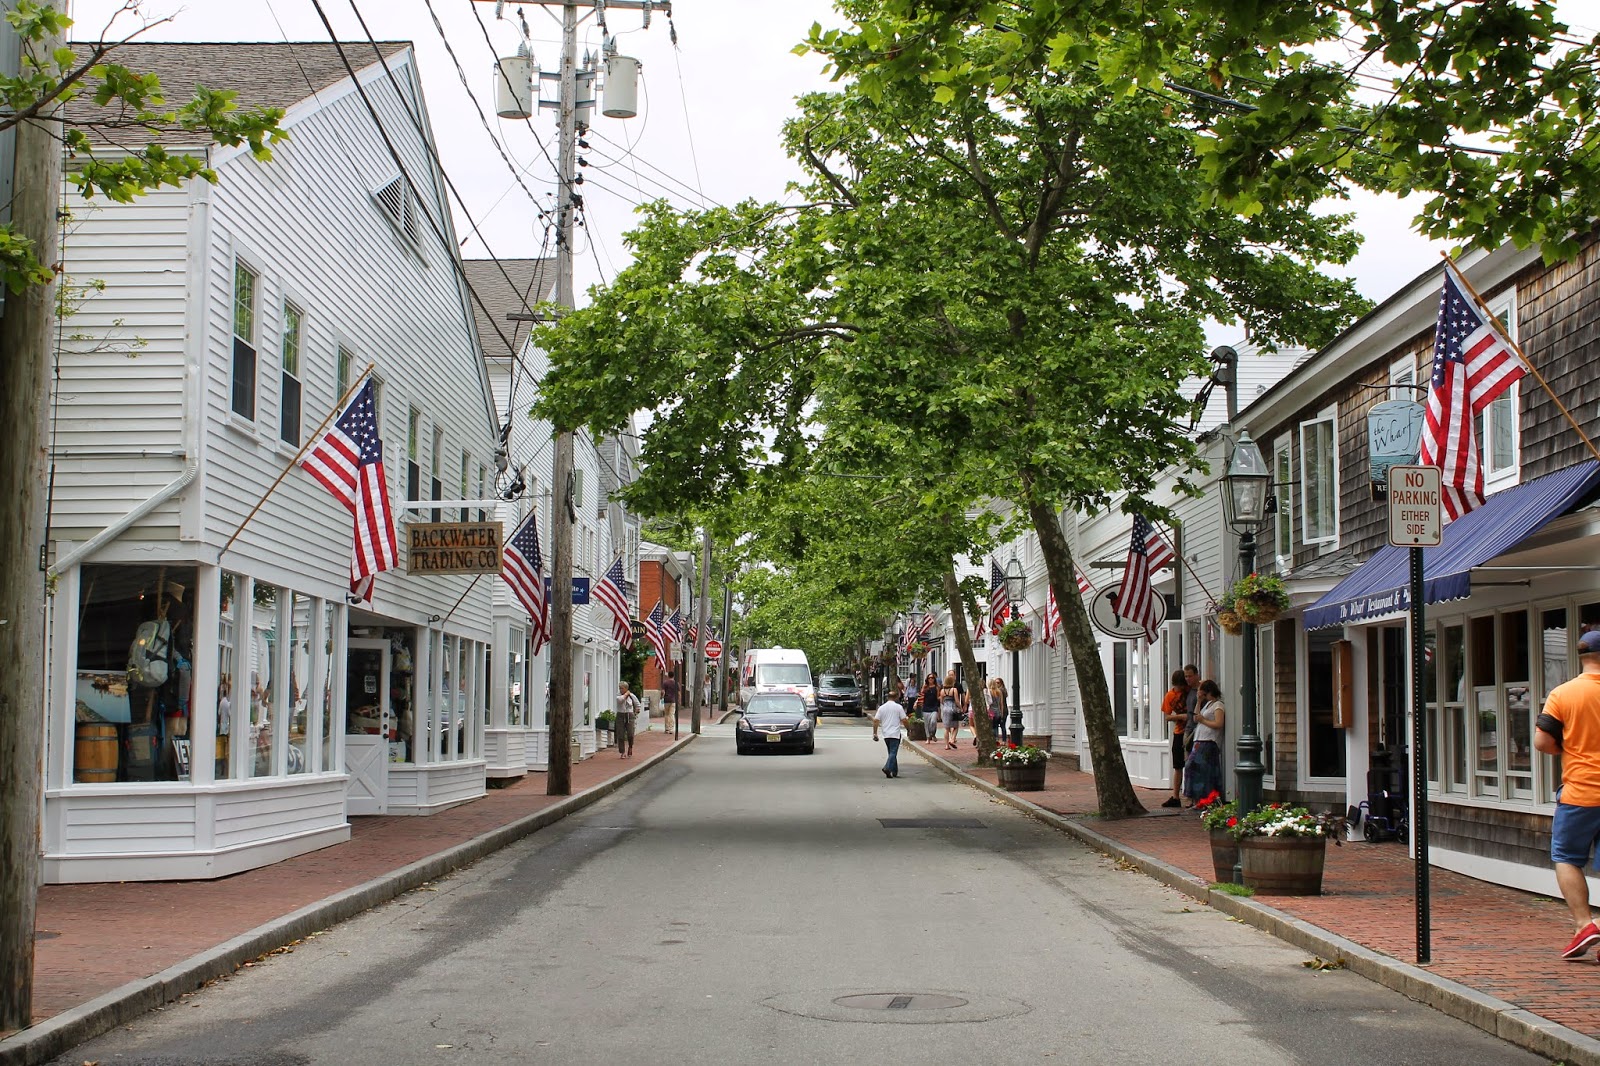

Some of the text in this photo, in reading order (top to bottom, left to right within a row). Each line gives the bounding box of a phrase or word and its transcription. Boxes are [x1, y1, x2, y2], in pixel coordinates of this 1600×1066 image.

[1373, 418, 1385, 436] the
[1374, 408, 1414, 451] Wharf
[1405, 473, 1424, 488] NO
[1393, 490, 1437, 506] PARKING
[1401, 510, 1430, 522] EITHER
[412, 528, 496, 547] BACKWATER
[1406, 524, 1425, 535] SIDE
[412, 550, 498, 569] TRADING CO.
[1350, 599, 1365, 616] Wharf
[1368, 594, 1393, 612] Restaurant
